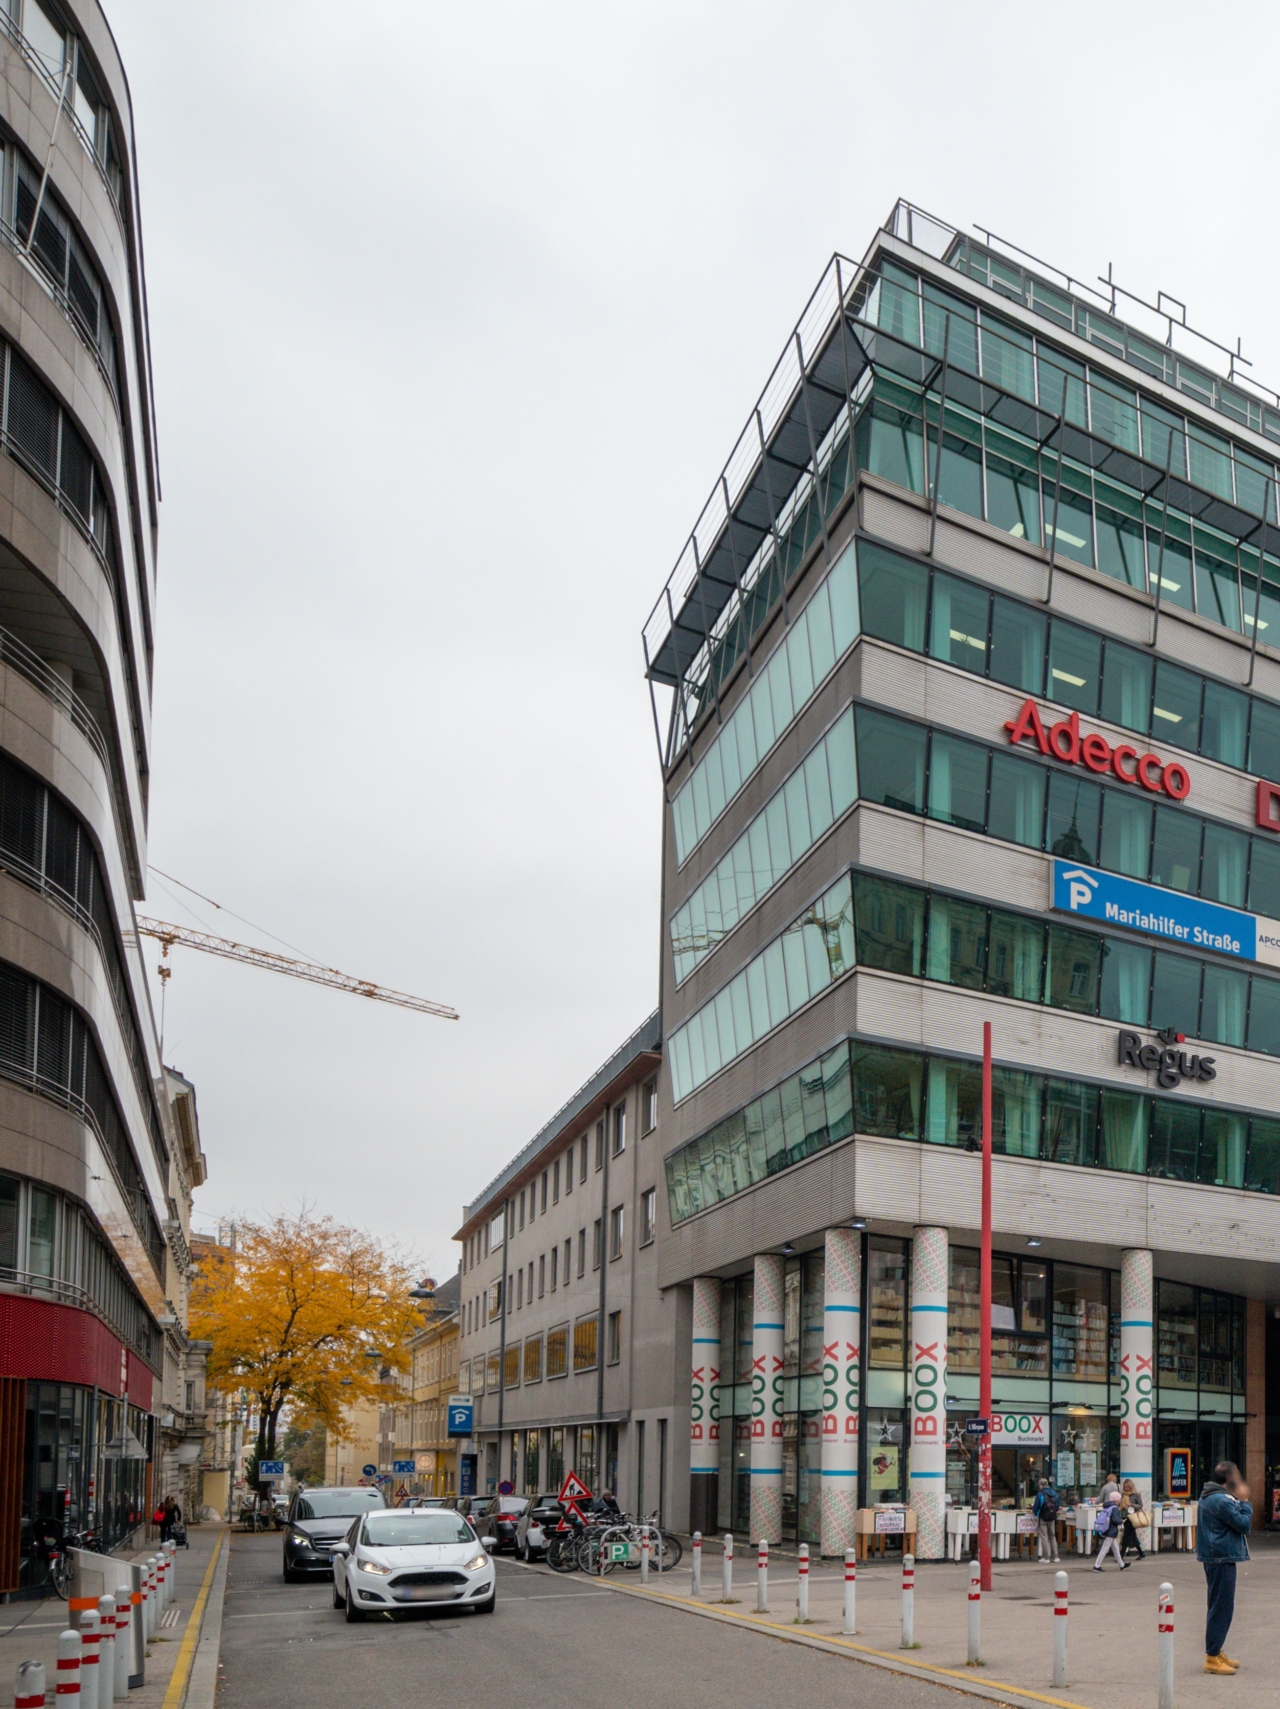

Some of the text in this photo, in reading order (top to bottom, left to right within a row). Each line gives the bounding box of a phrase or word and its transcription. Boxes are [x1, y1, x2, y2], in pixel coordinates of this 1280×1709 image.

[1003, 698, 1191, 800] Adecco
[1070, 881, 1093, 910] P
[1105, 902, 1241, 954] Mariahilfer Straße
[1118, 1027, 1217, 1089] Regus
[914, 1341, 939, 1436] BOOX
[455, 1413, 466, 1425] P
[991, 1415, 1043, 1434] BOOX
[1172, 1478, 1186, 1487] HOFER
[612, 1545, 624, 1560] P
